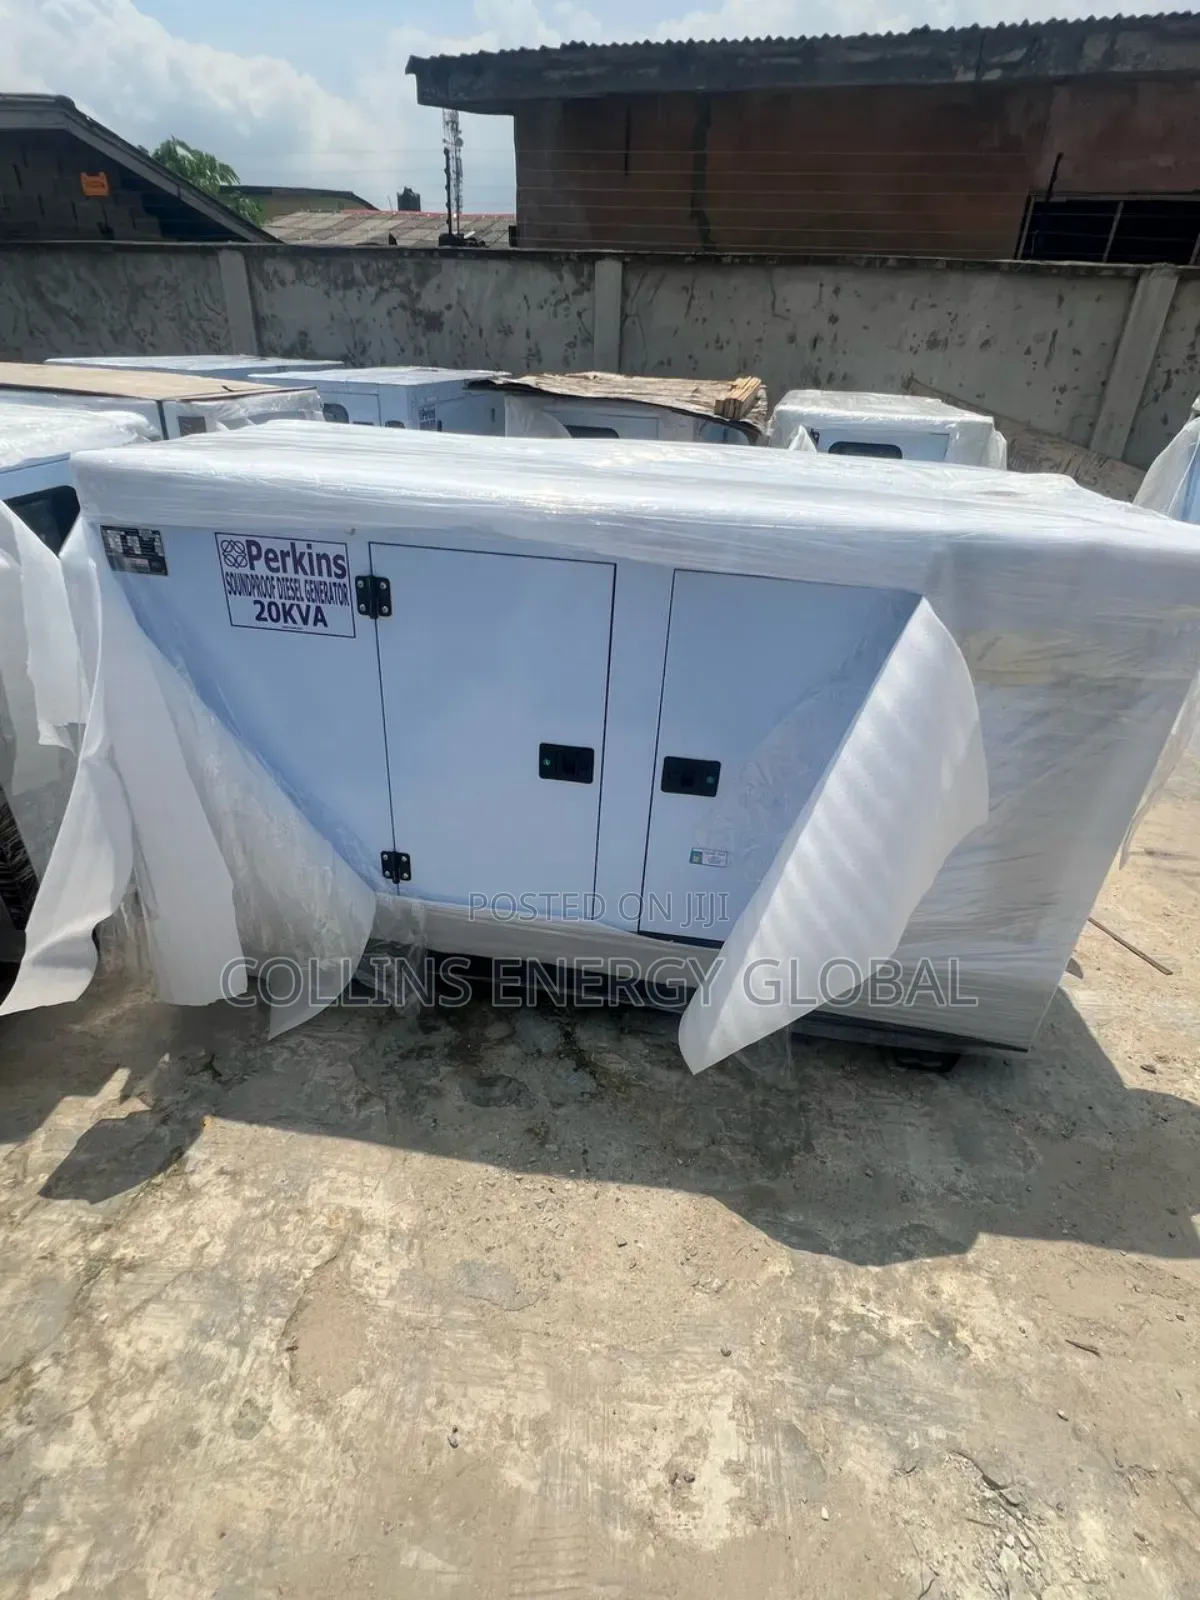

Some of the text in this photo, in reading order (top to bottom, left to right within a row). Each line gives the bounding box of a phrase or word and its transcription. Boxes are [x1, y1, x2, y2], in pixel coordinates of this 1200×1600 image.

[245, 539, 347, 579] Perkins
[225, 571, 350, 607] SOUNDPROOF DIESEL GENERATOR
[253, 599, 328, 628] 20KVA
